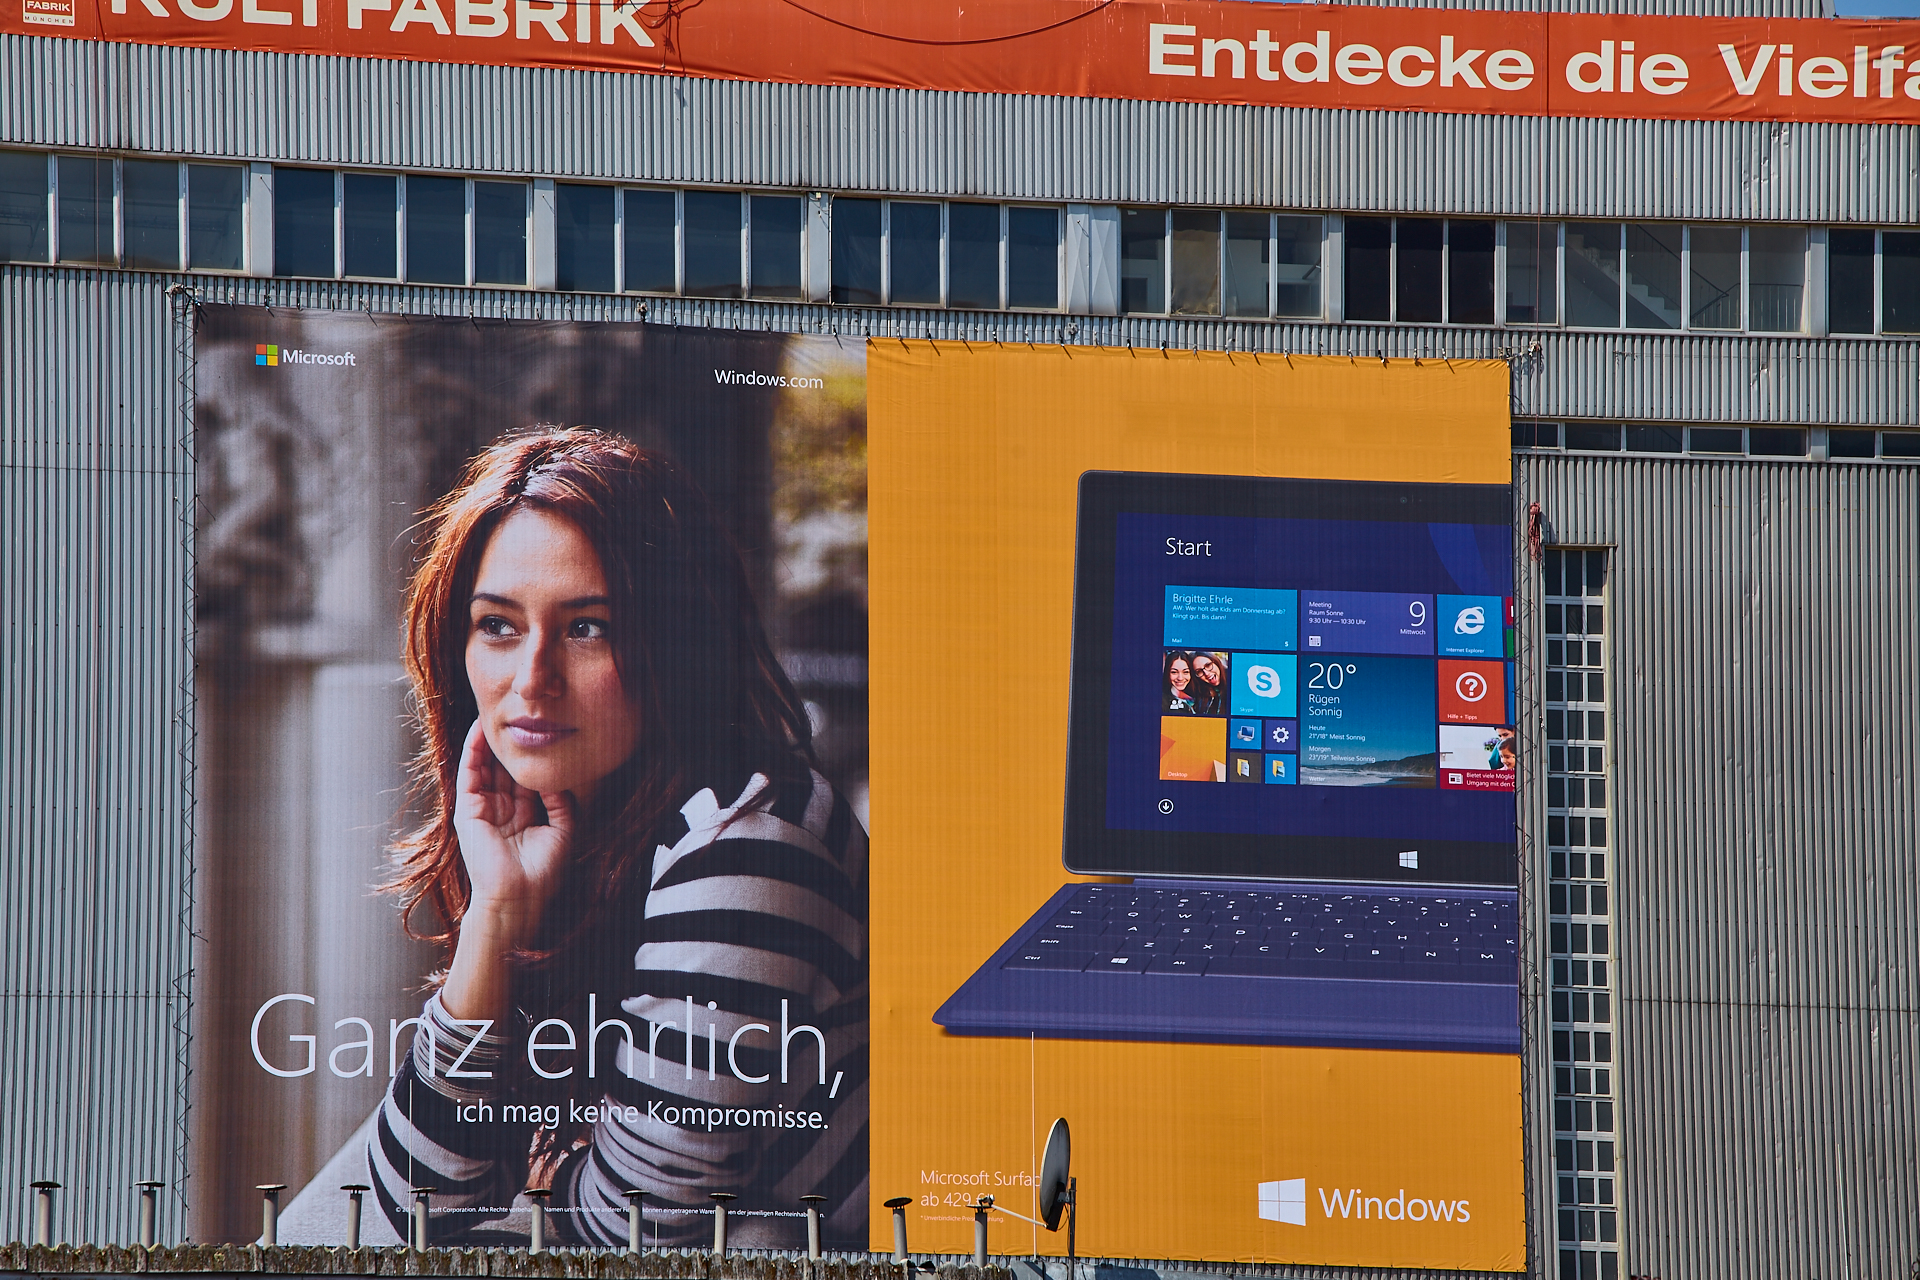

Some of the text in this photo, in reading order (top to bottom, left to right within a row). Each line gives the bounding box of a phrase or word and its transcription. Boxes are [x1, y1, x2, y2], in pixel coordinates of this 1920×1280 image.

[27, 1, 70, 11] FABRIK
[25, 16, 73, 24] MÜNCHEN
[1148, 23, 1535, 91] Entdecke
[1566, 40, 1689, 95] die
[283, 348, 356, 367] Microsoft
[715, 368, 824, 390] Windows.com
[1165, 537, 1212, 557] Start
[1172, 594, 1233, 604] Brigitte Ehrle
[1410, 601, 1426, 626] 9
[1308, 662, 1356, 689] 20°
[1309, 694, 1340, 706] Rügen
[1309, 706, 1342, 718] Sonnig
[1346, 734, 1365, 742] Sonnig
[250, 993, 845, 1098] Ganz ehrlich,
[456, 1098, 829, 1134] ich mag keine Kompromisse.
[921, 1170, 1041, 1186] Microsoft Surfac
[921, 1192, 939, 1206] ab
[943, 1193, 971, 1207] 429
[1319, 1187, 1470, 1223] Windows
